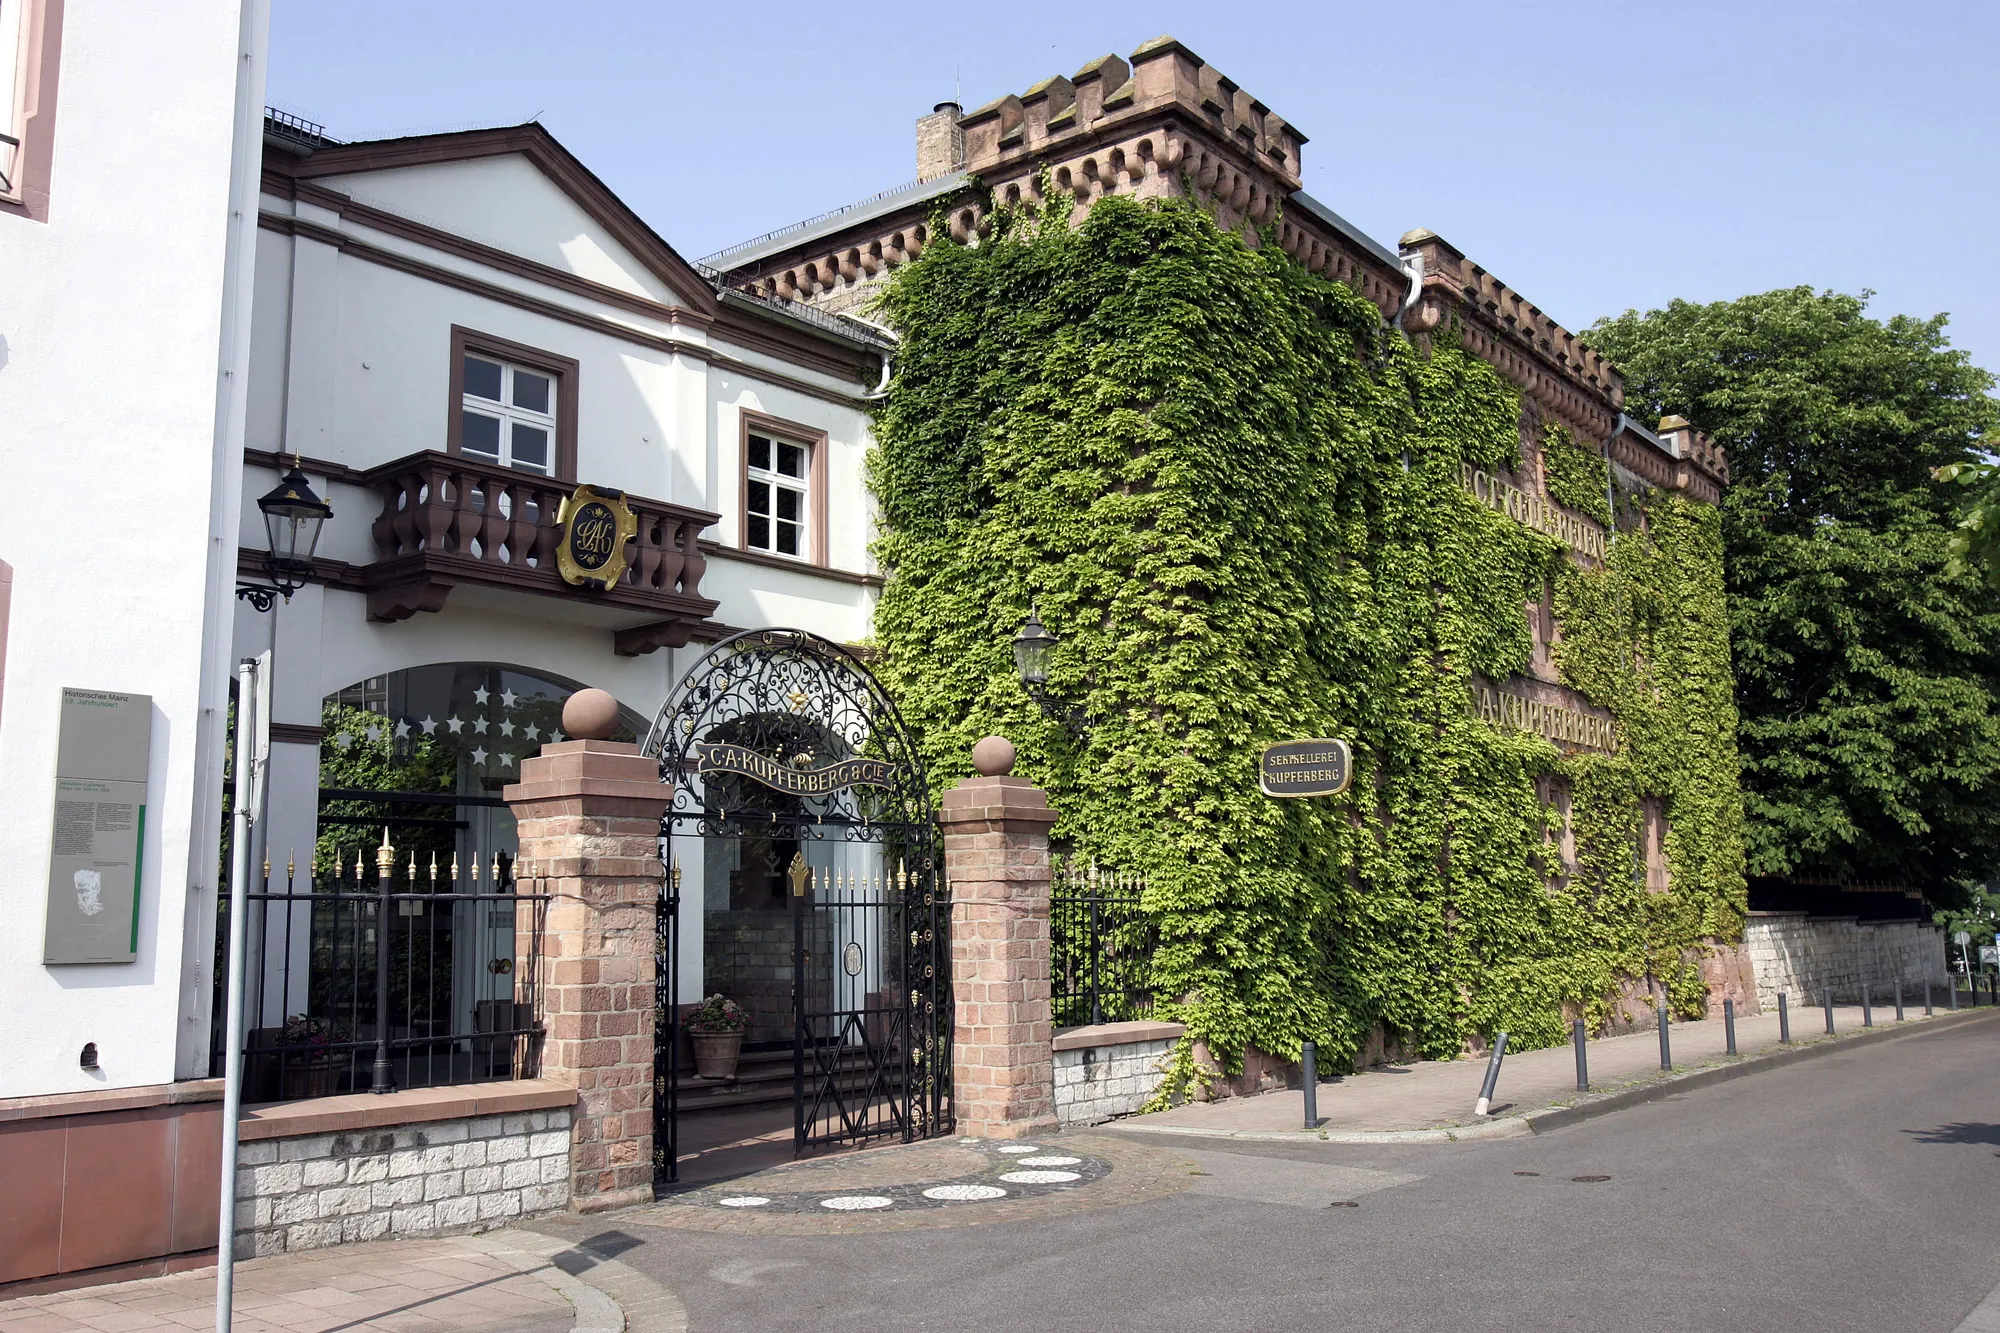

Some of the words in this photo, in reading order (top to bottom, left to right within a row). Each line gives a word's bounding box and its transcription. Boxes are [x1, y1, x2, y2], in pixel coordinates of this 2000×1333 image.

[65, 690, 107, 700] Historisches
[109, 694, 129, 702] Mainz
[77, 698, 118, 709] Jahrhundert
[1270, 752, 1337, 766] SEKTKELLEREI
[852, 766, 861, 780] &
[1269, 769, 1339, 784] KUPFERBERG
